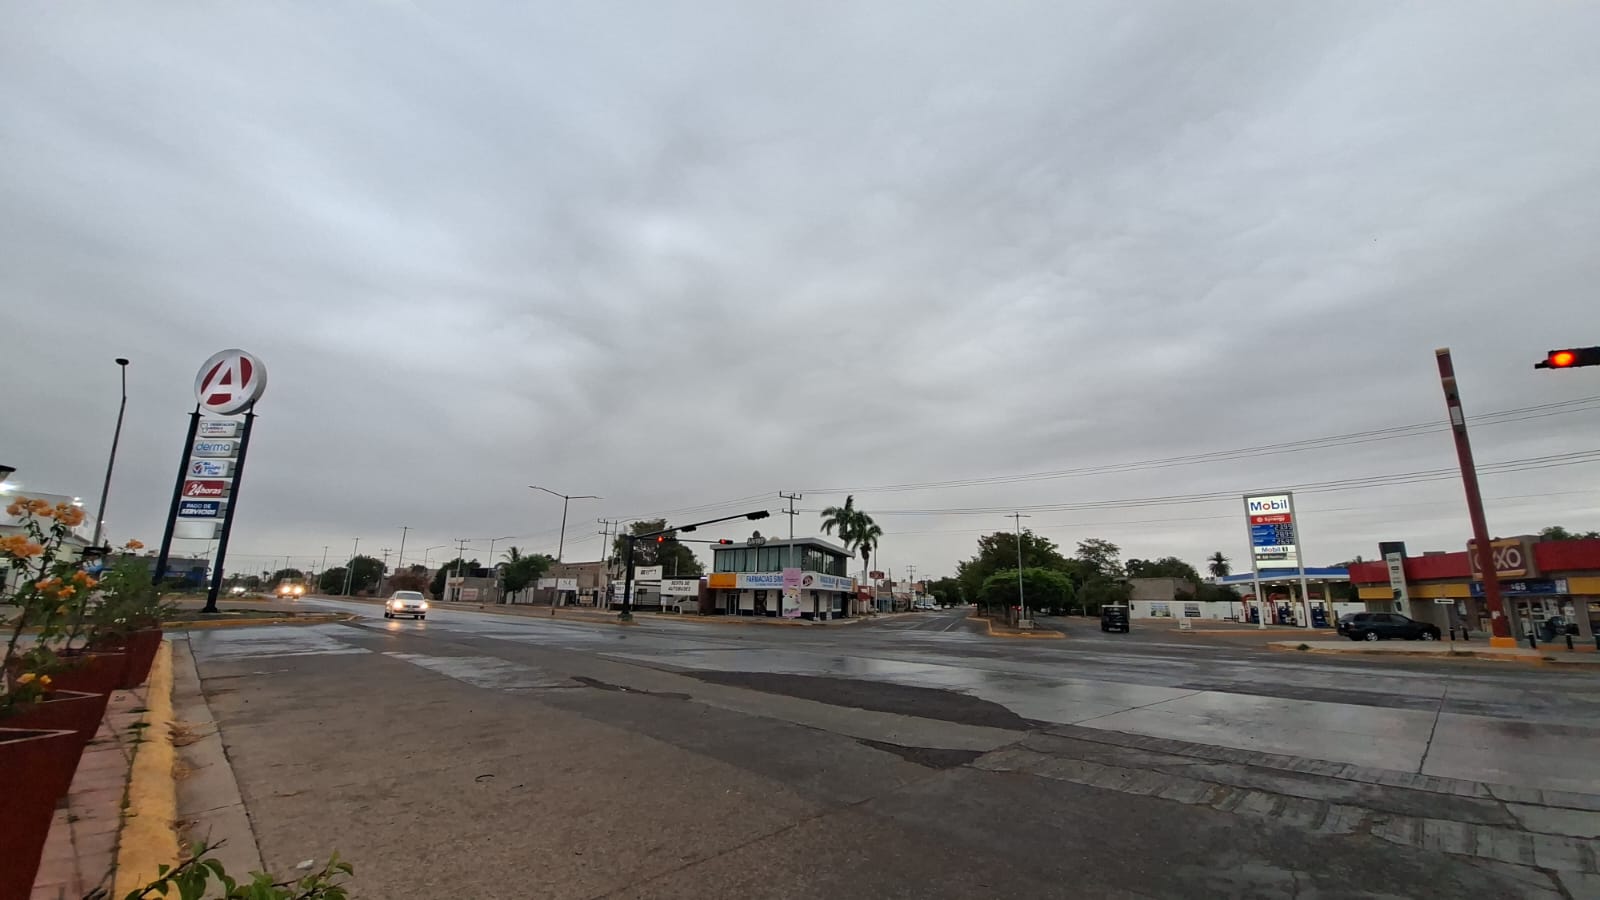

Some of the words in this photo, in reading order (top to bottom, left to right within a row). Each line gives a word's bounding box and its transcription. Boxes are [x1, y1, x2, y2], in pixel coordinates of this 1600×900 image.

[195, 442, 230, 451] derma
[1250, 500, 1287, 511] Mobil
[746, 575, 772, 583] FARMACIAS
